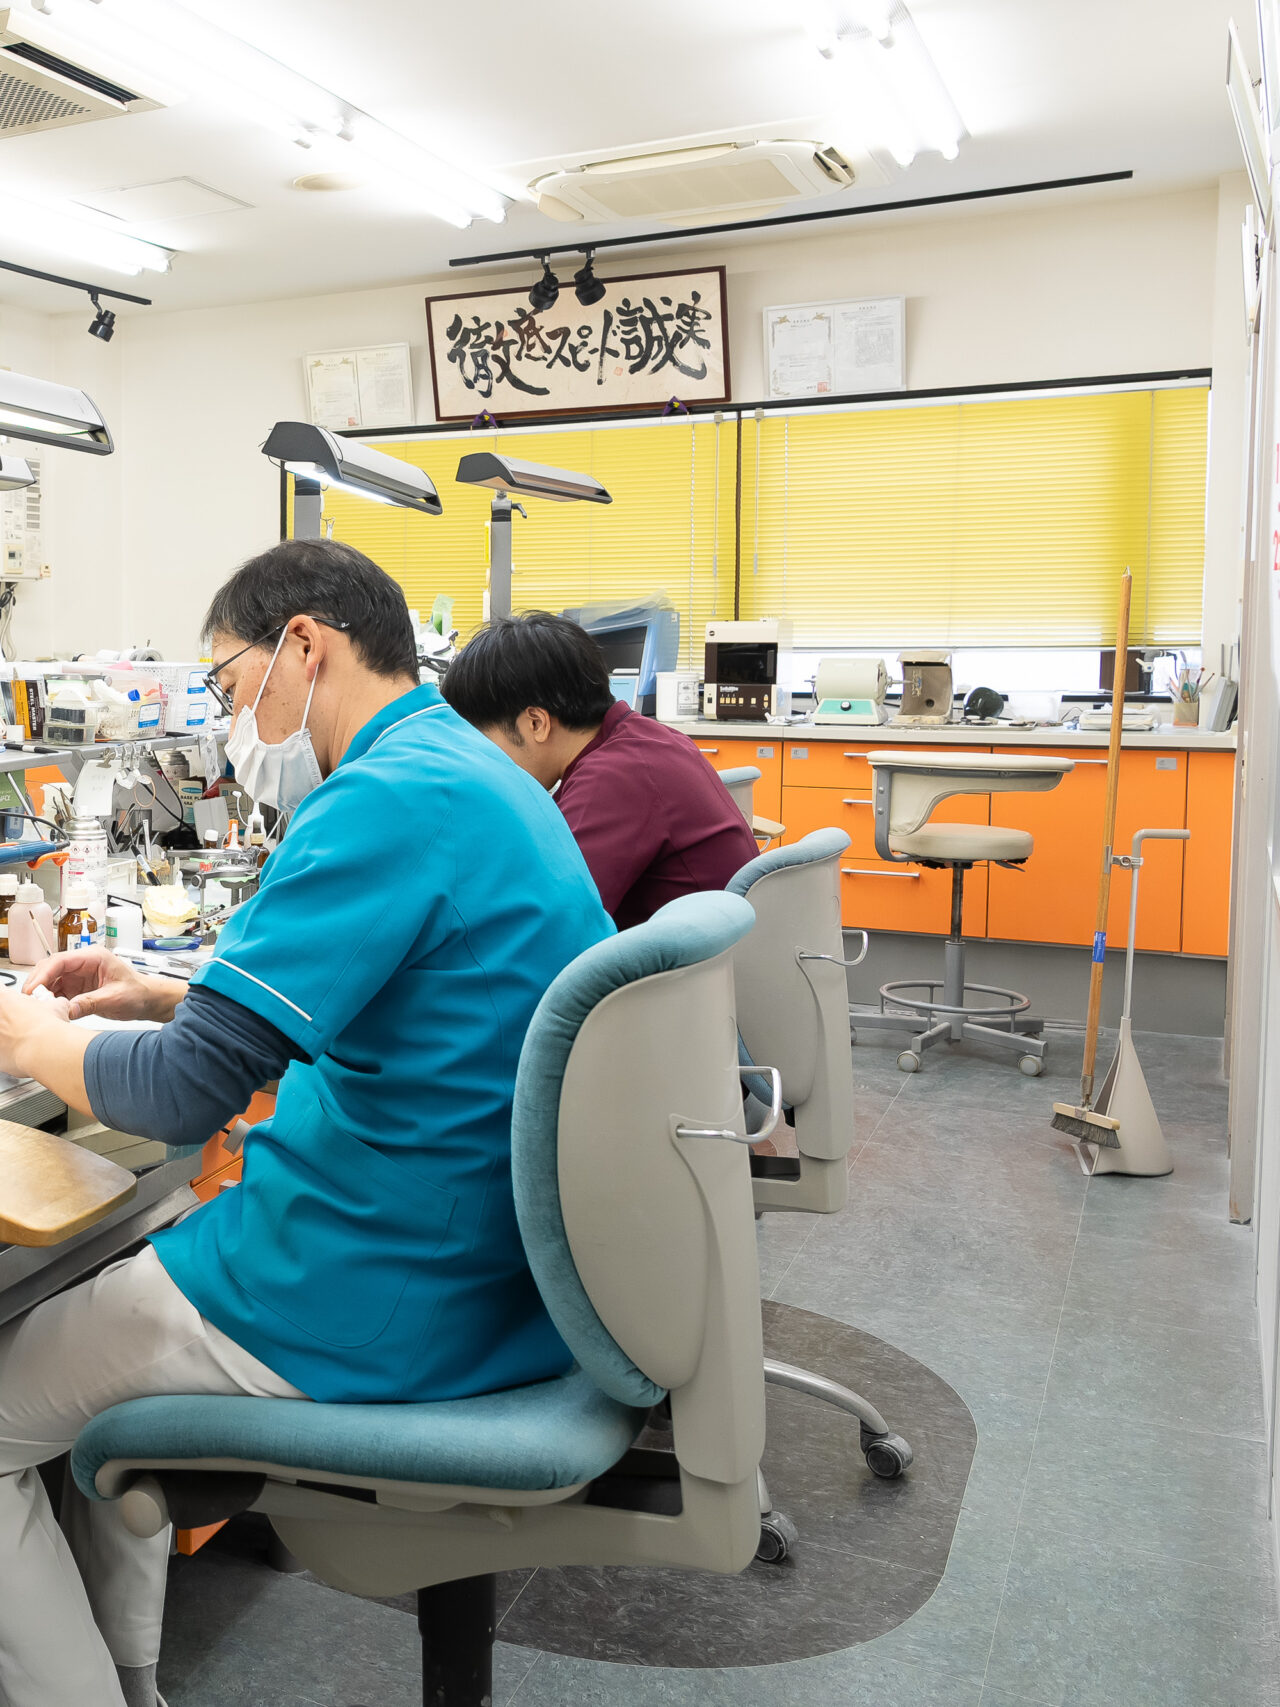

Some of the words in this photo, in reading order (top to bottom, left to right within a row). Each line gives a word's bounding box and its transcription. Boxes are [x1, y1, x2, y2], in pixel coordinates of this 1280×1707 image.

[446, 290, 712, 398] 徹底スピード誠実
